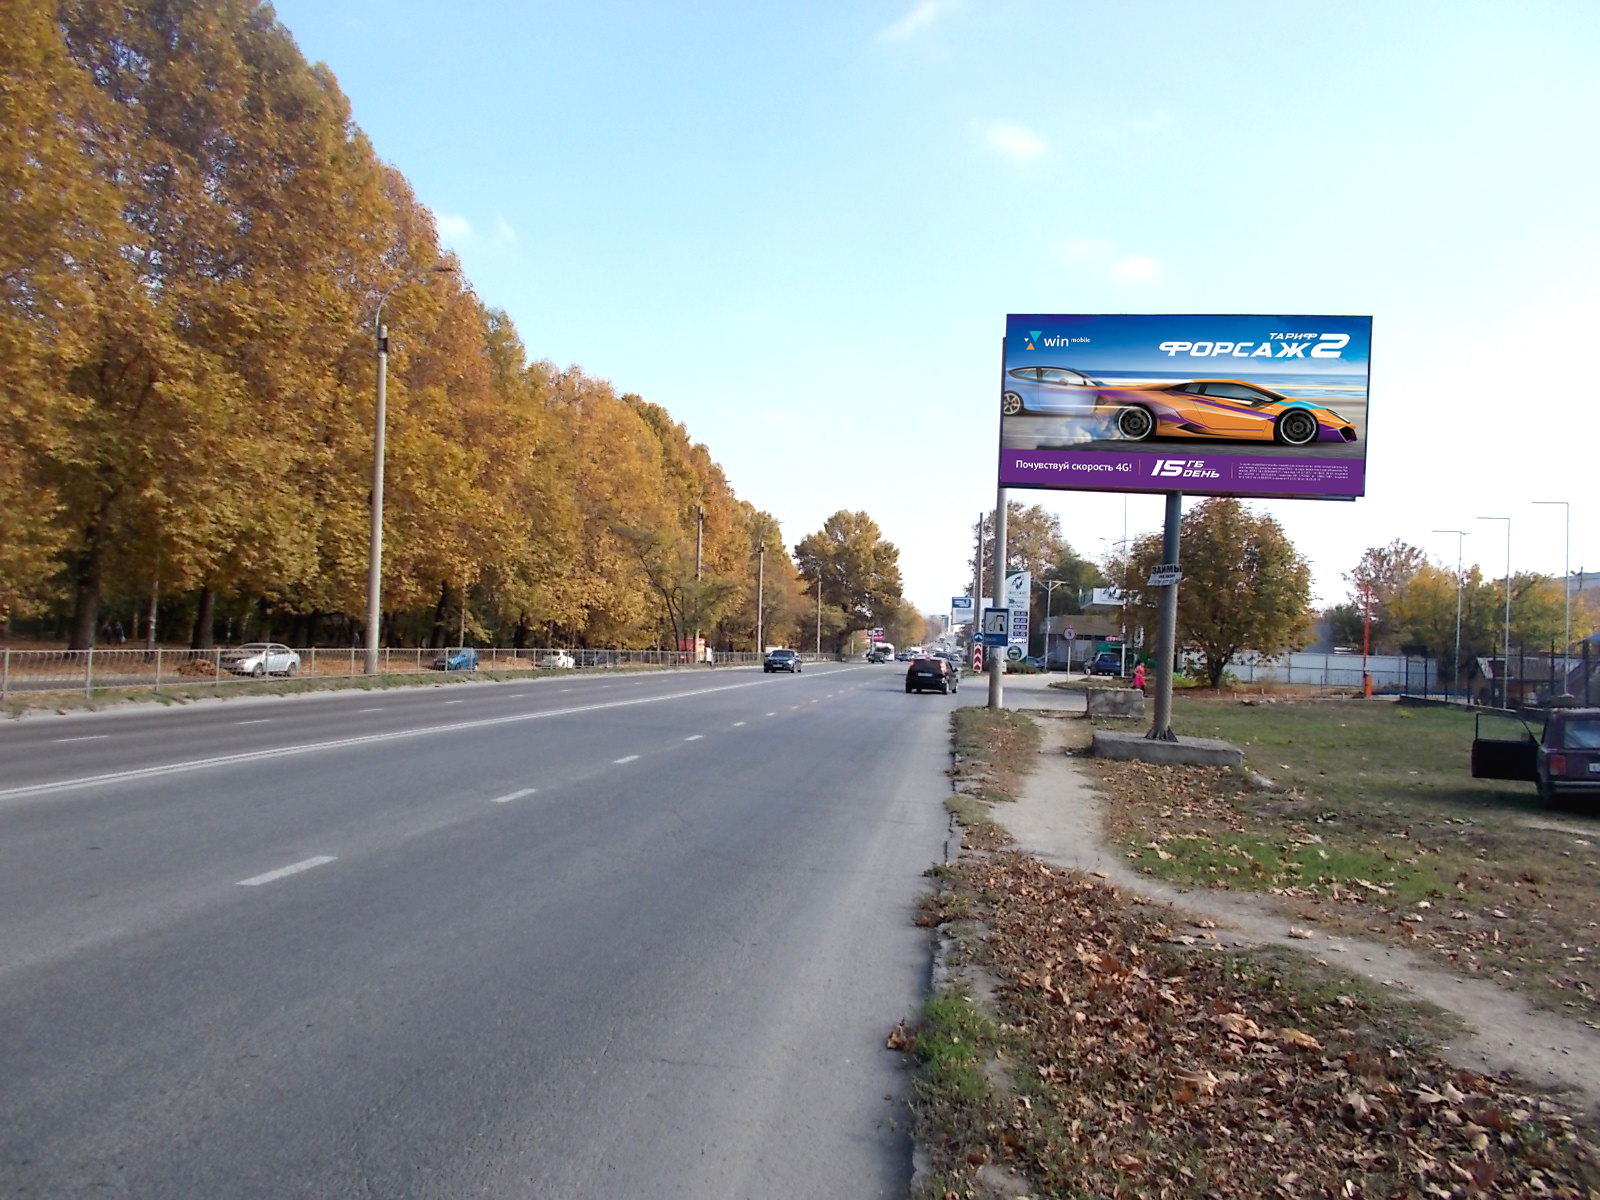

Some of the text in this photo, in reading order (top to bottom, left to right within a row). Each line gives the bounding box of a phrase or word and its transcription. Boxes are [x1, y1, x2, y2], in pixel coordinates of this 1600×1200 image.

[1044, 335, 1069, 347] win
[1158, 334, 1350, 358] ФОРСАЖ 2
[1016, 460, 1132, 472] Почувствуй скорость 4G!
[1150, 459, 1186, 477] 15
